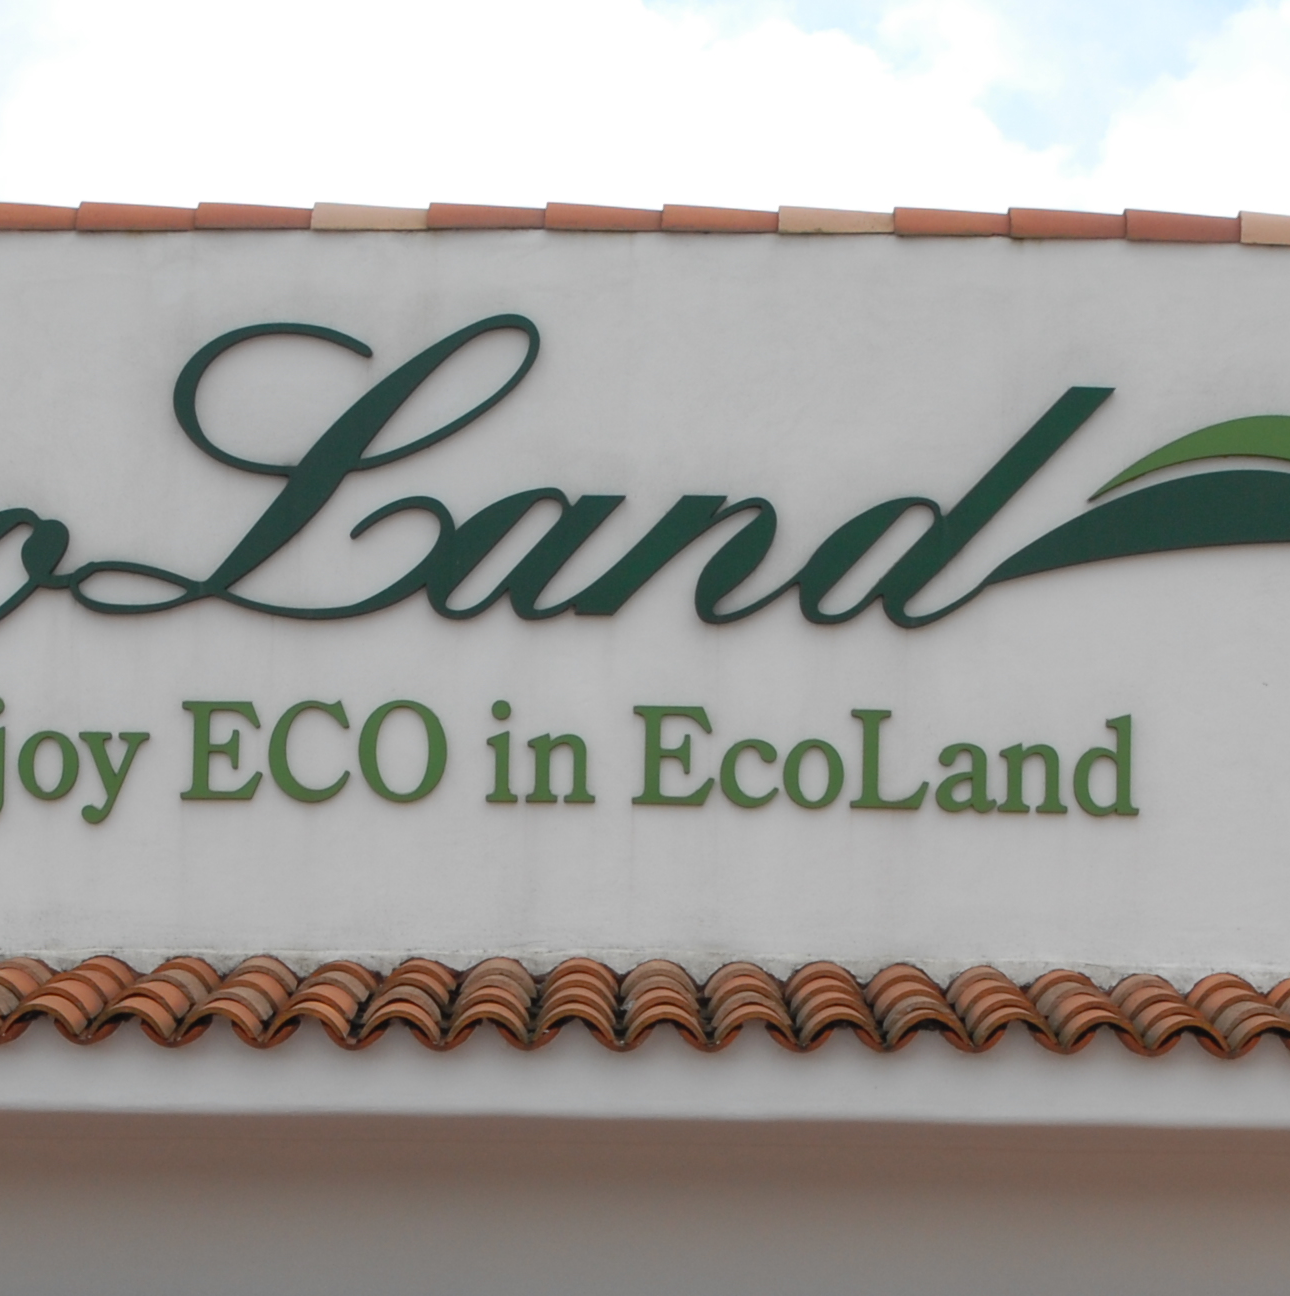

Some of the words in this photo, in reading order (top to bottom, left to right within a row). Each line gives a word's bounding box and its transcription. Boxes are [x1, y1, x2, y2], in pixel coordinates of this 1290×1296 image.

[180, 699, 449, 803] ECO
[484, 700, 595, 804] in
[632, 705, 1140, 817] EcoLand
